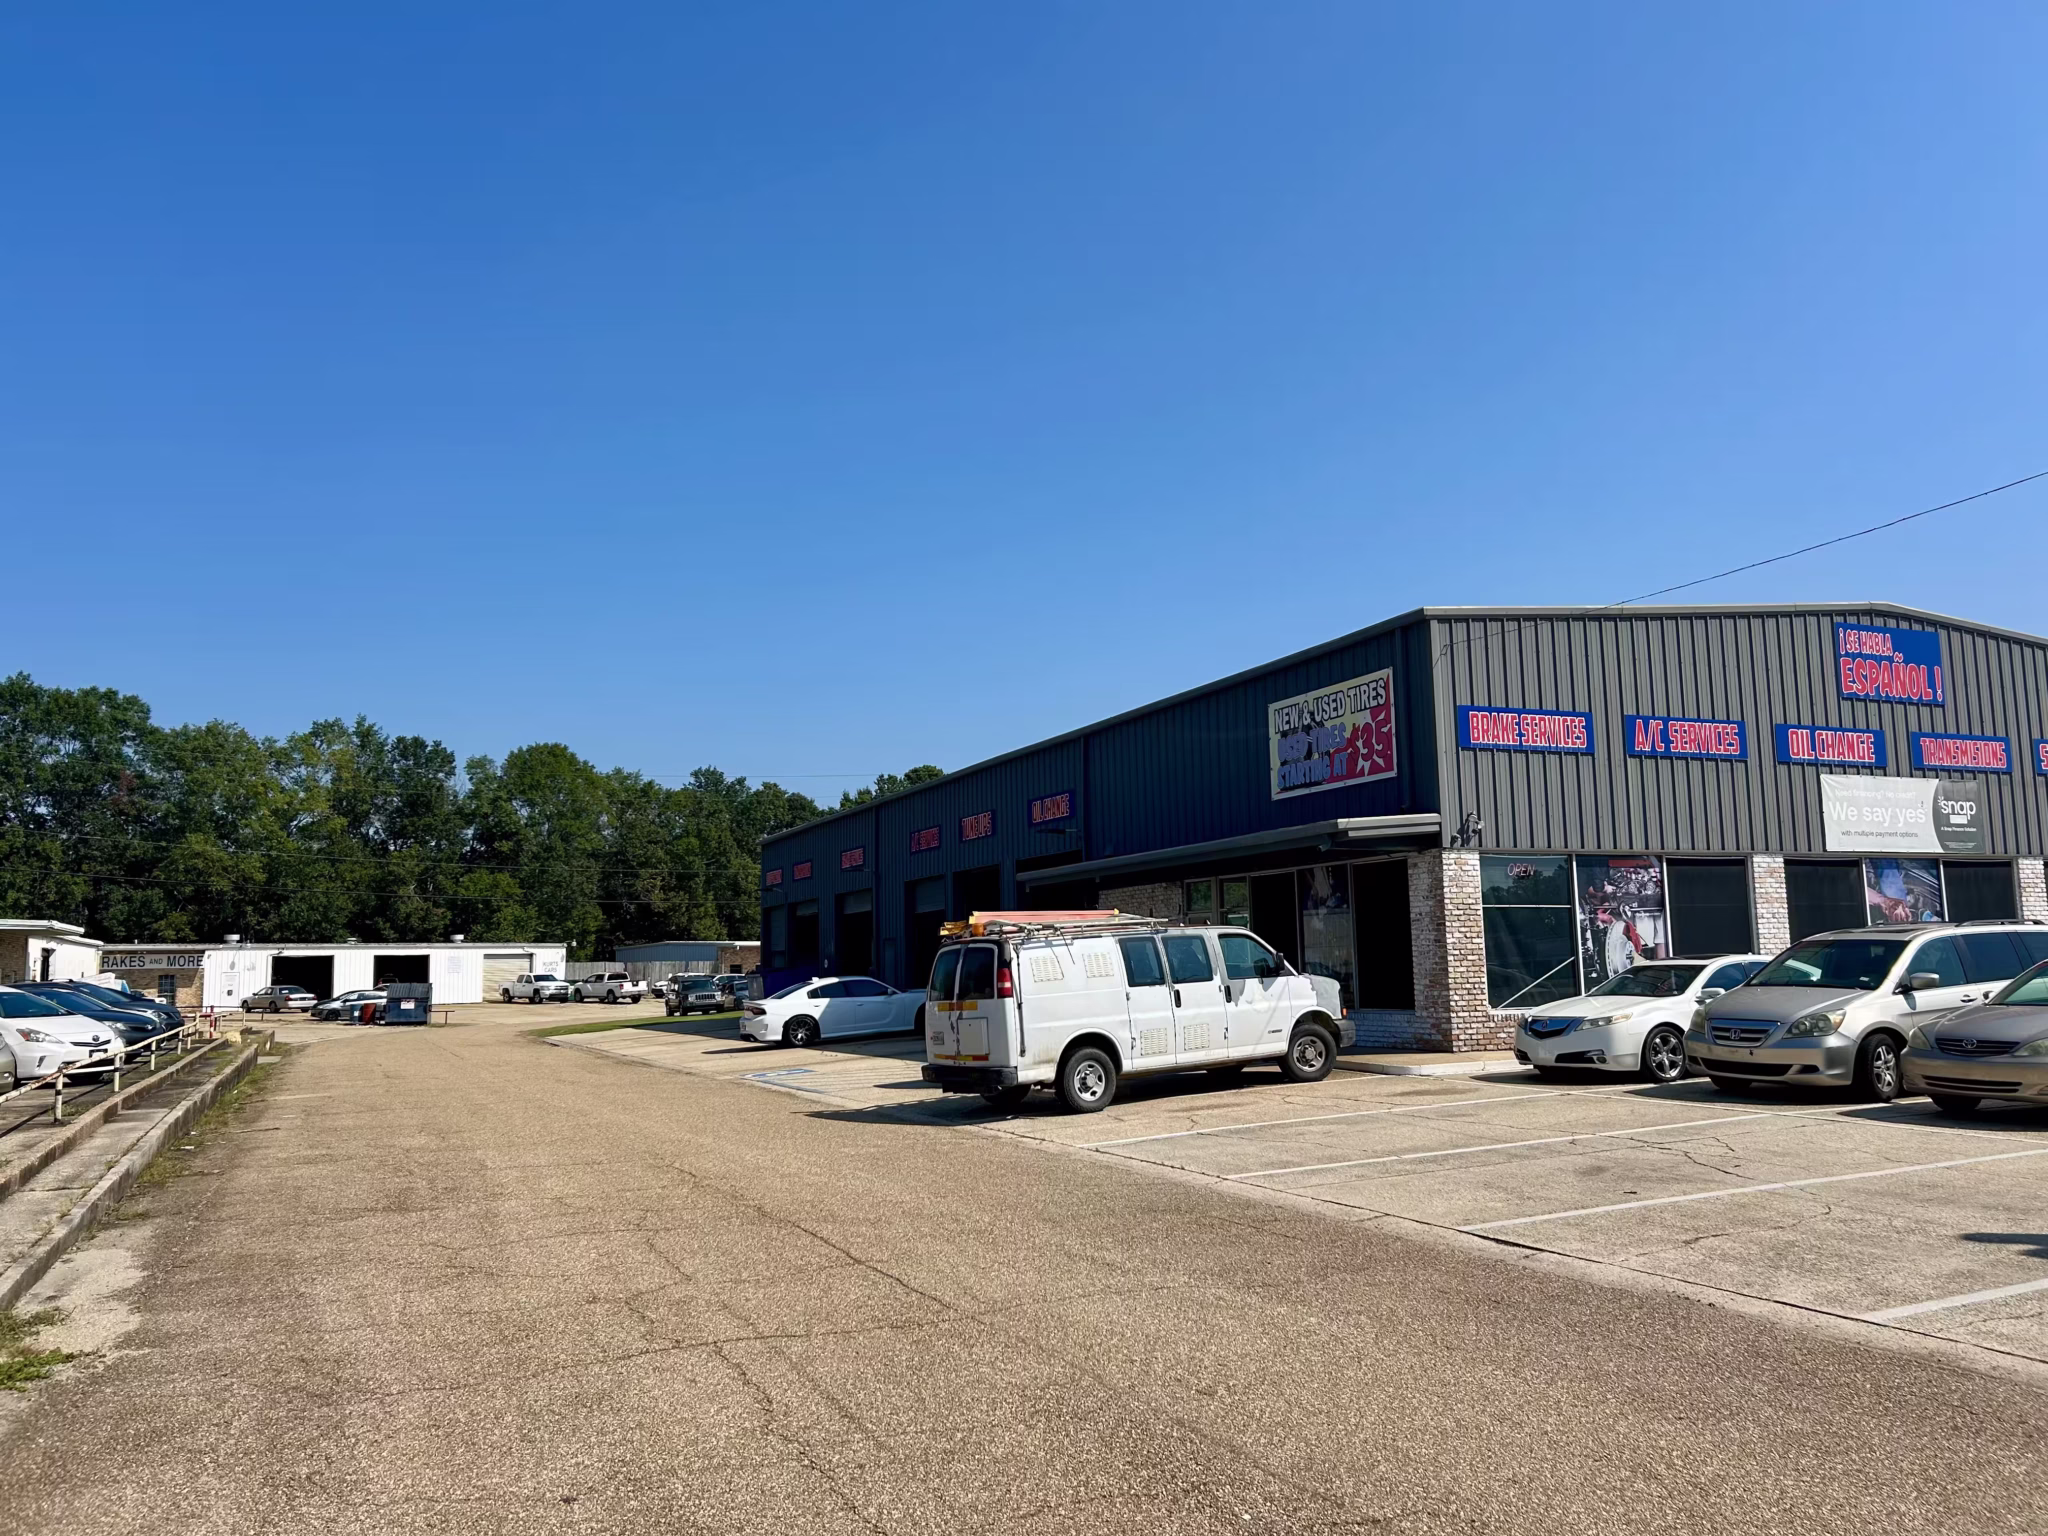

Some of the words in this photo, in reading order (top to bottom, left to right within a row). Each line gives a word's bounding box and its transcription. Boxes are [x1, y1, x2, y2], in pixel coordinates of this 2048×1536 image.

[1860, 631, 1893, 656] HABLA
[1274, 703, 1300, 734] NEW
[1300, 700, 1311, 724] &
[1312, 690, 1346, 723] USED
[1347, 678, 1387, 714] TIRES
[1310, 722, 1347, 754] TIRES
[1469, 711, 1520, 744] BRAKE
[1521, 714, 1587, 748] SERVICES
[1635, 719, 1665, 751] A/C
[1669, 721, 1740, 754] SERVICES
[1788, 729, 1815, 759] OIL
[1815, 731, 1875, 762] CHANGE
[1920, 737, 2007, 769] TRANSMISIONS
[1277, 755, 1331, 790] STARTING
[1334, 752, 1349, 776] AT
[1828, 801, 1858, 821] We
[1862, 806, 1892, 827] say
[1896, 808, 1926, 828] yes
[1940, 800, 1977, 821] snap
[1853, 830, 1875, 838] multiple
[1875, 831, 1898, 839] payment
[1898, 831, 1919, 839] options
[1507, 863, 1536, 876] OPEN
[101, 955, 146, 968] RAKES
[149, 958, 163, 966] AND
[167, 955, 204, 967] MORE
